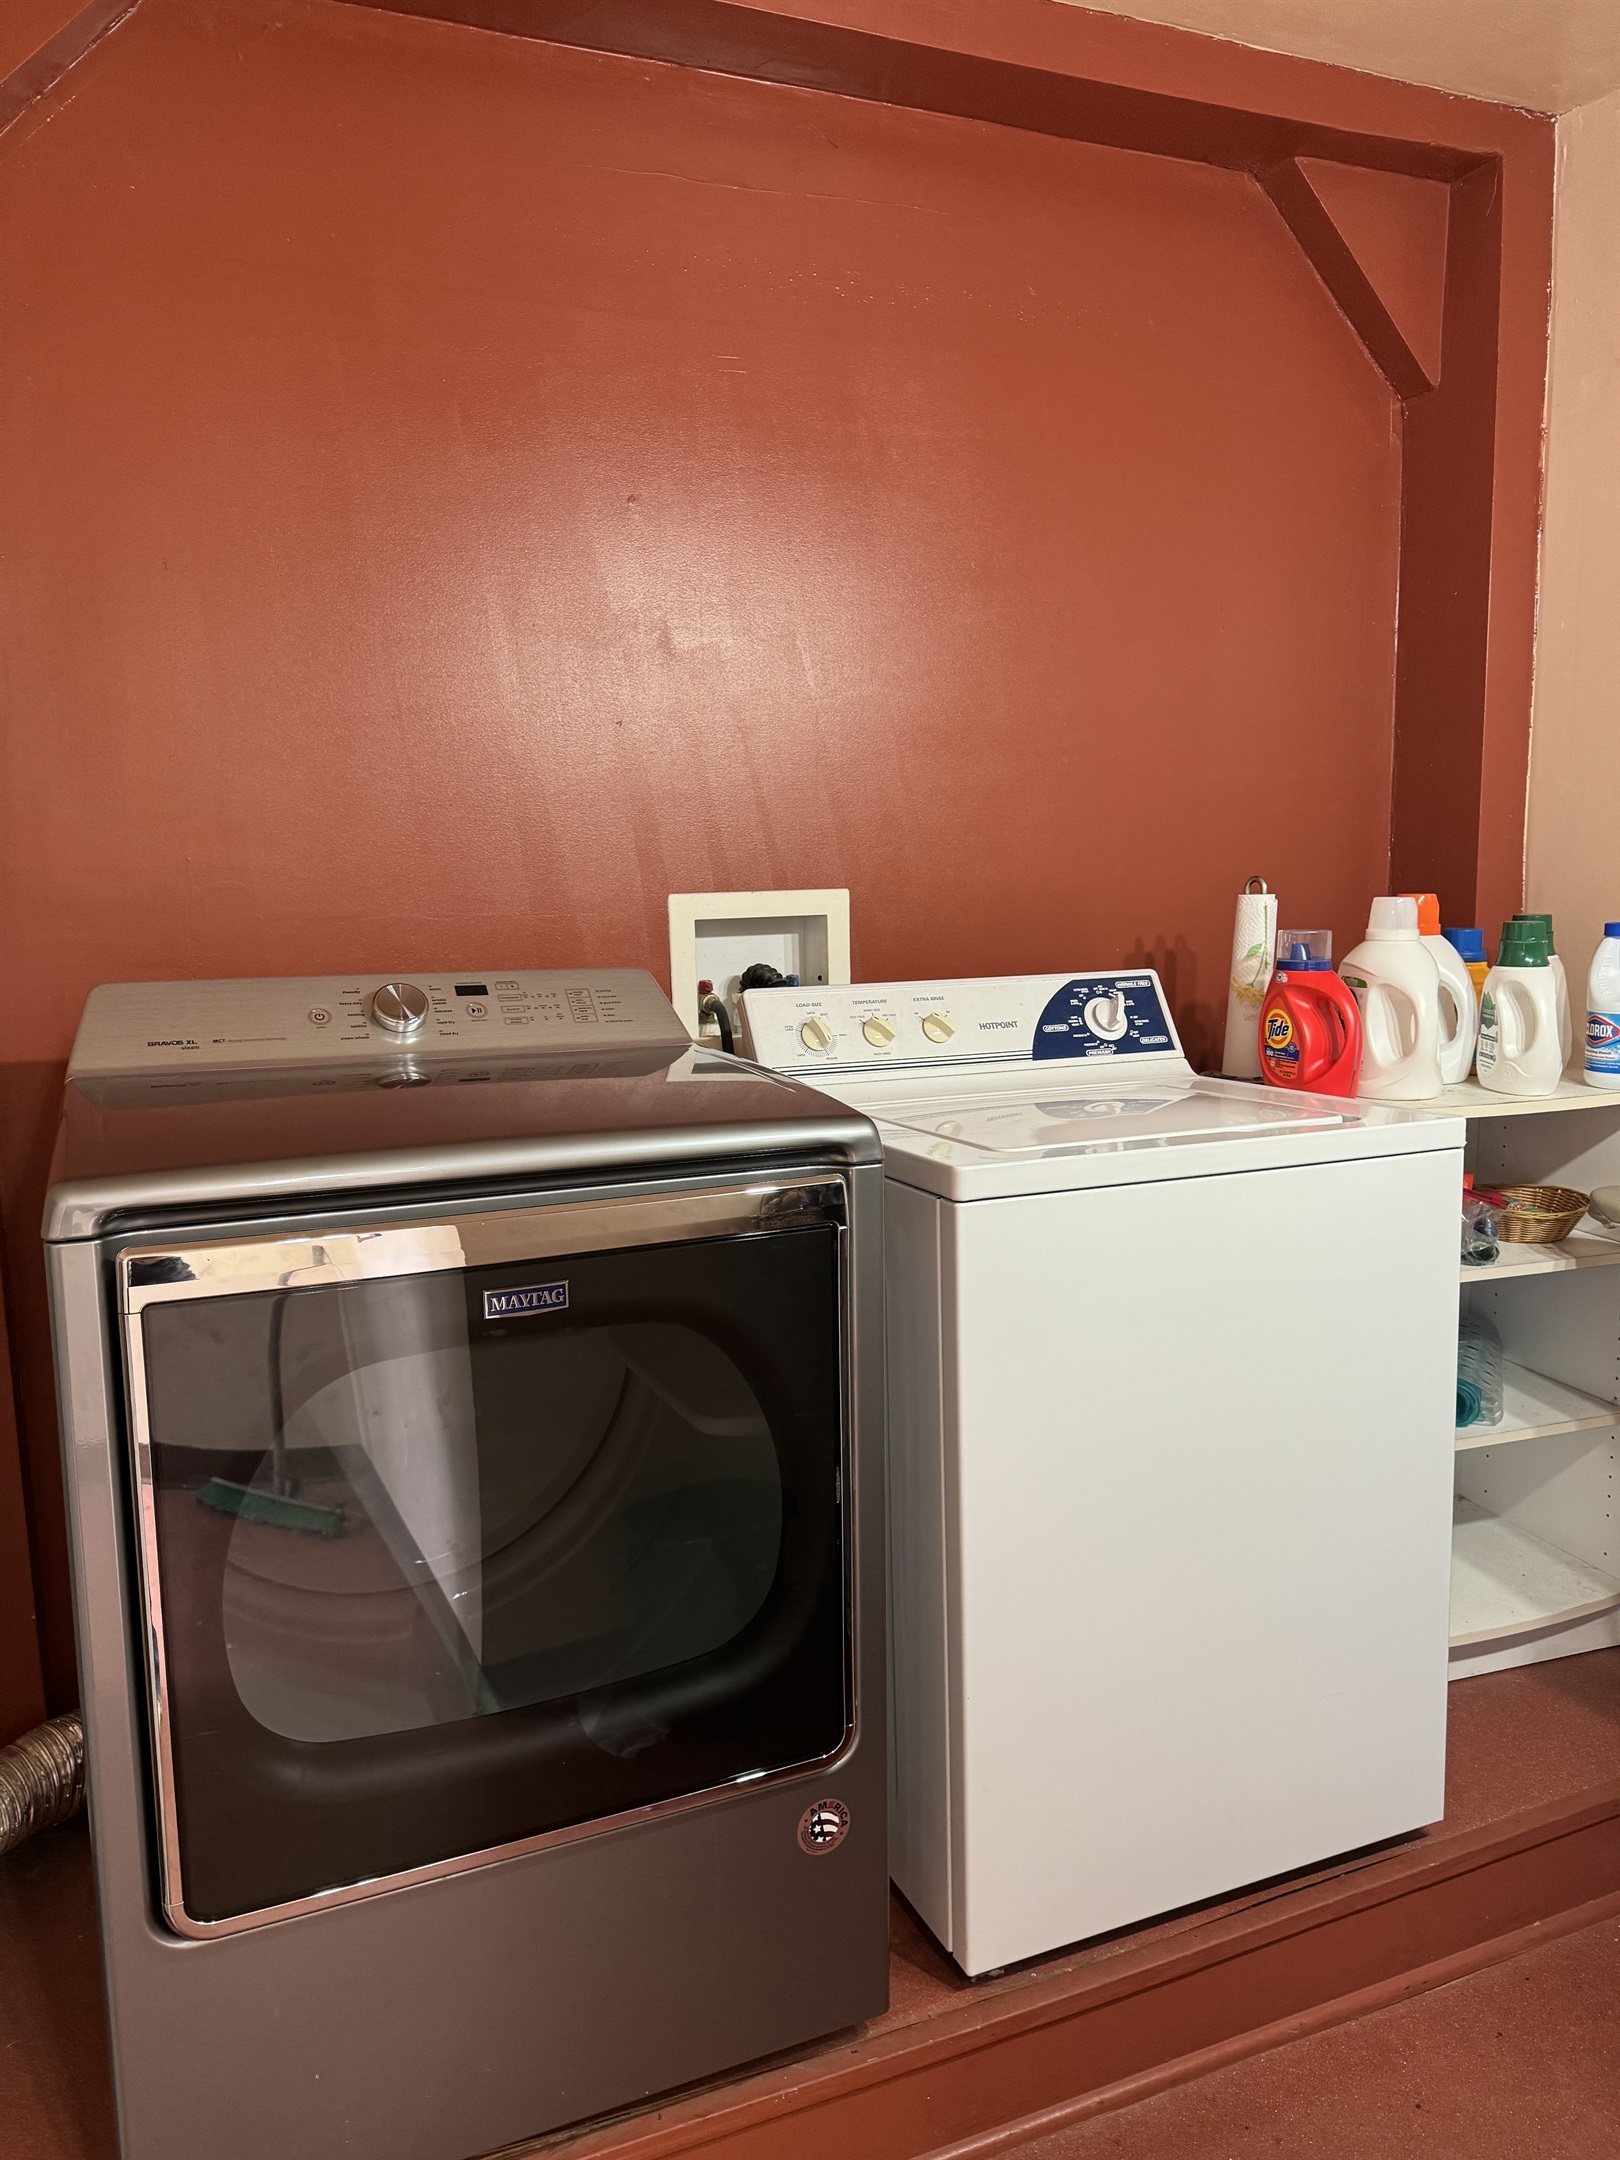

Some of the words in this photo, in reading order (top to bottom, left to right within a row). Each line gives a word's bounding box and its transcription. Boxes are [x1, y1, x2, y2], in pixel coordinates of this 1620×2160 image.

[979, 1020, 1018, 1030] HOTPOINT
[1268, 1019, 1290, 1040] Tide
[490, 1288, 565, 1312] MAYTAG
[809, 1800, 849, 1828] AMERICA
